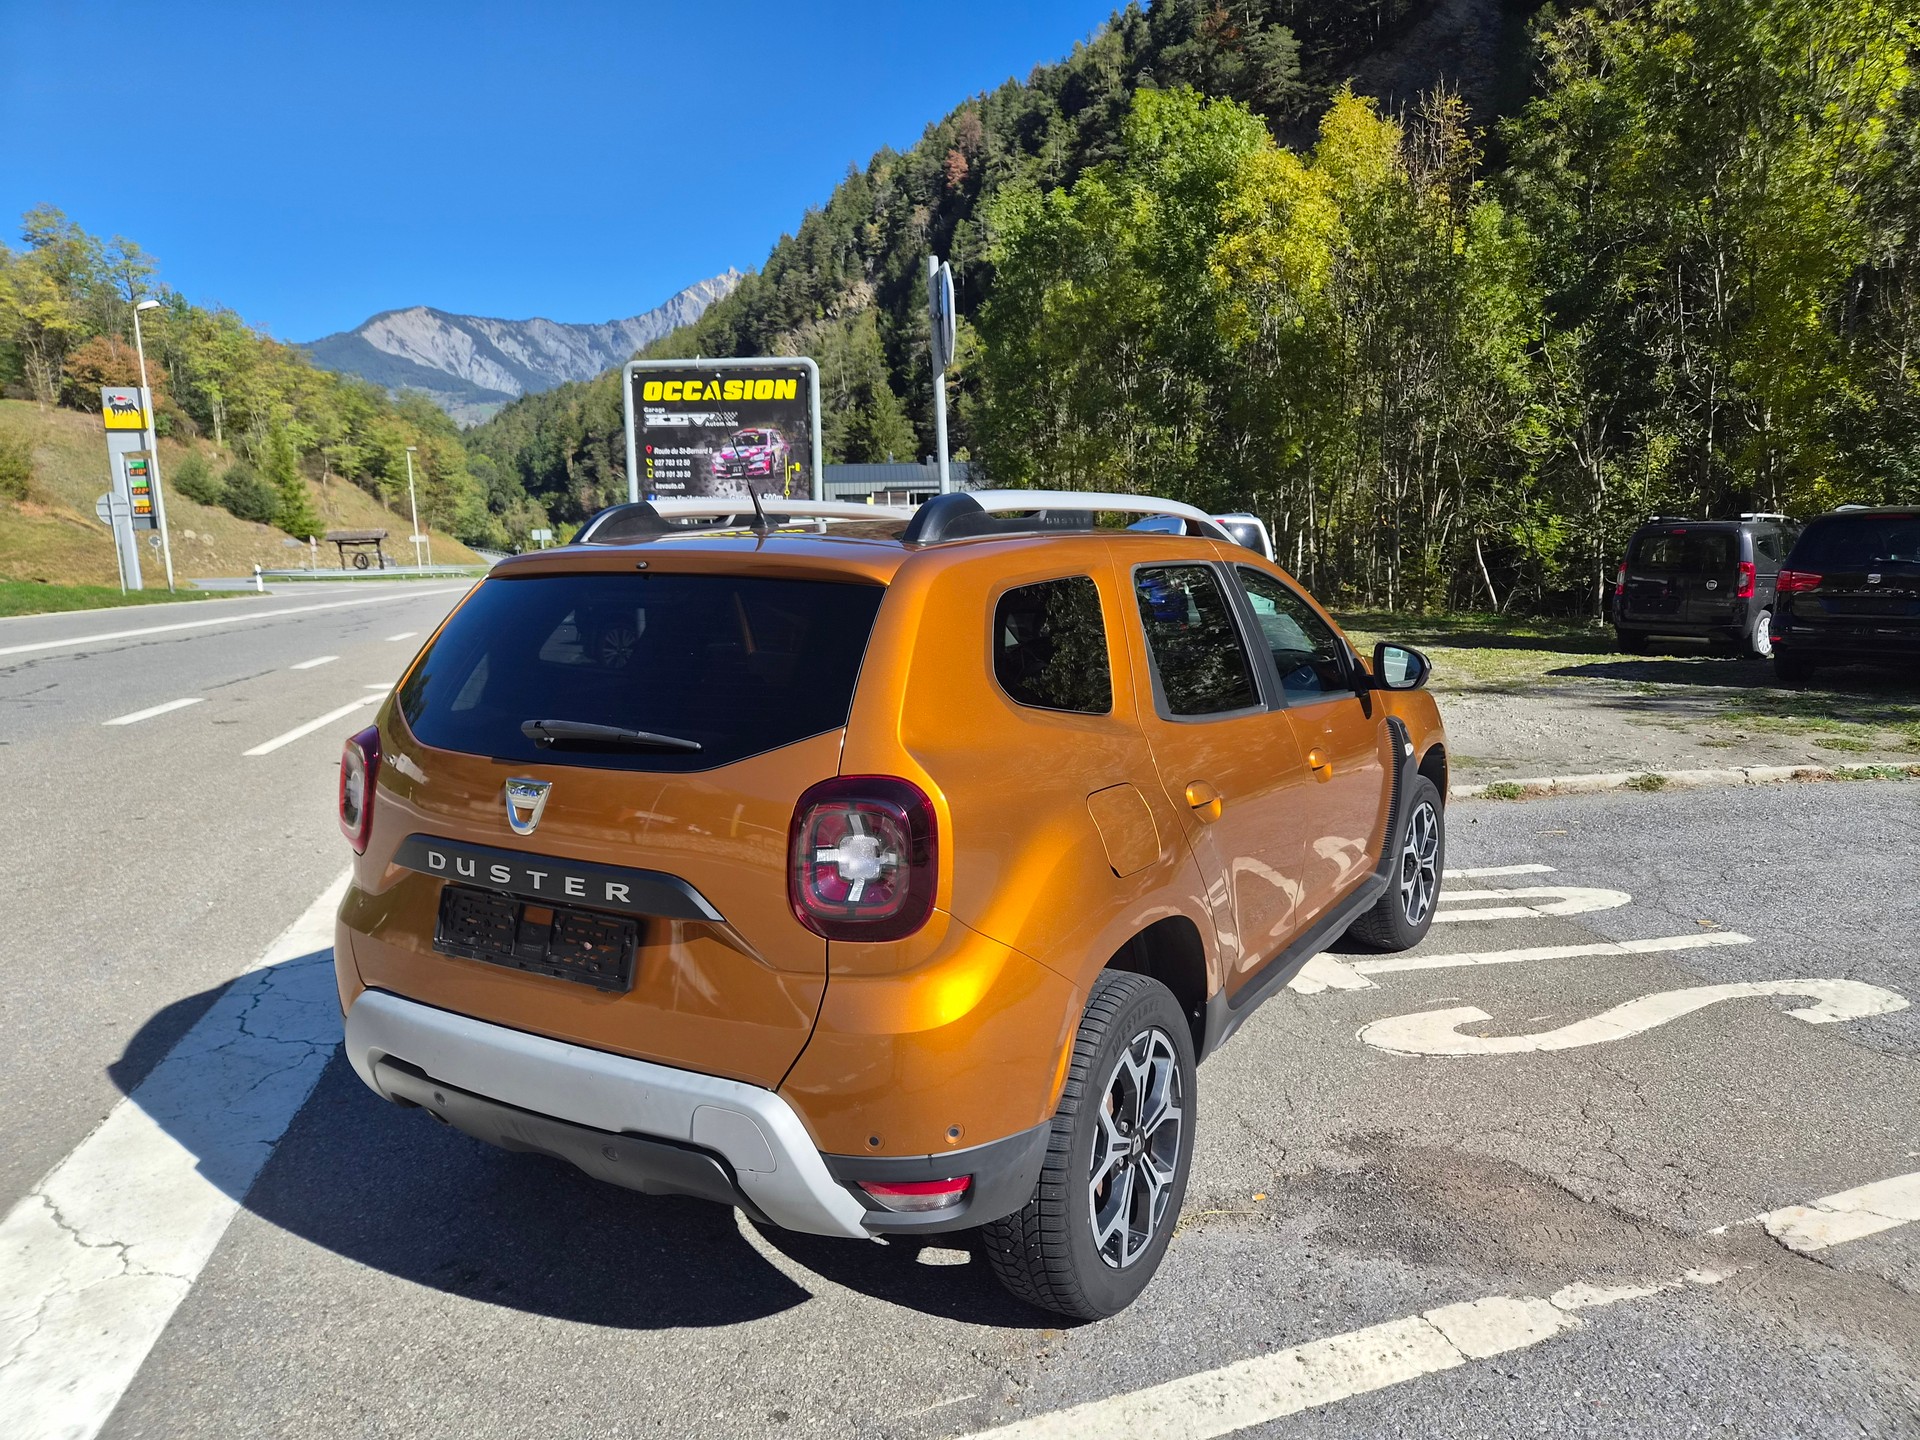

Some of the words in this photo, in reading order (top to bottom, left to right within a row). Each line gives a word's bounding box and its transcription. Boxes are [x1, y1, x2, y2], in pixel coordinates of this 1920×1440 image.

[643, 379, 797, 401] OCCASION
[655, 470, 665, 478] 079
[666, 470, 675, 478] 101
[655, 482, 685, 490] kevauto.ch
[427, 851, 631, 903] DUSTER
